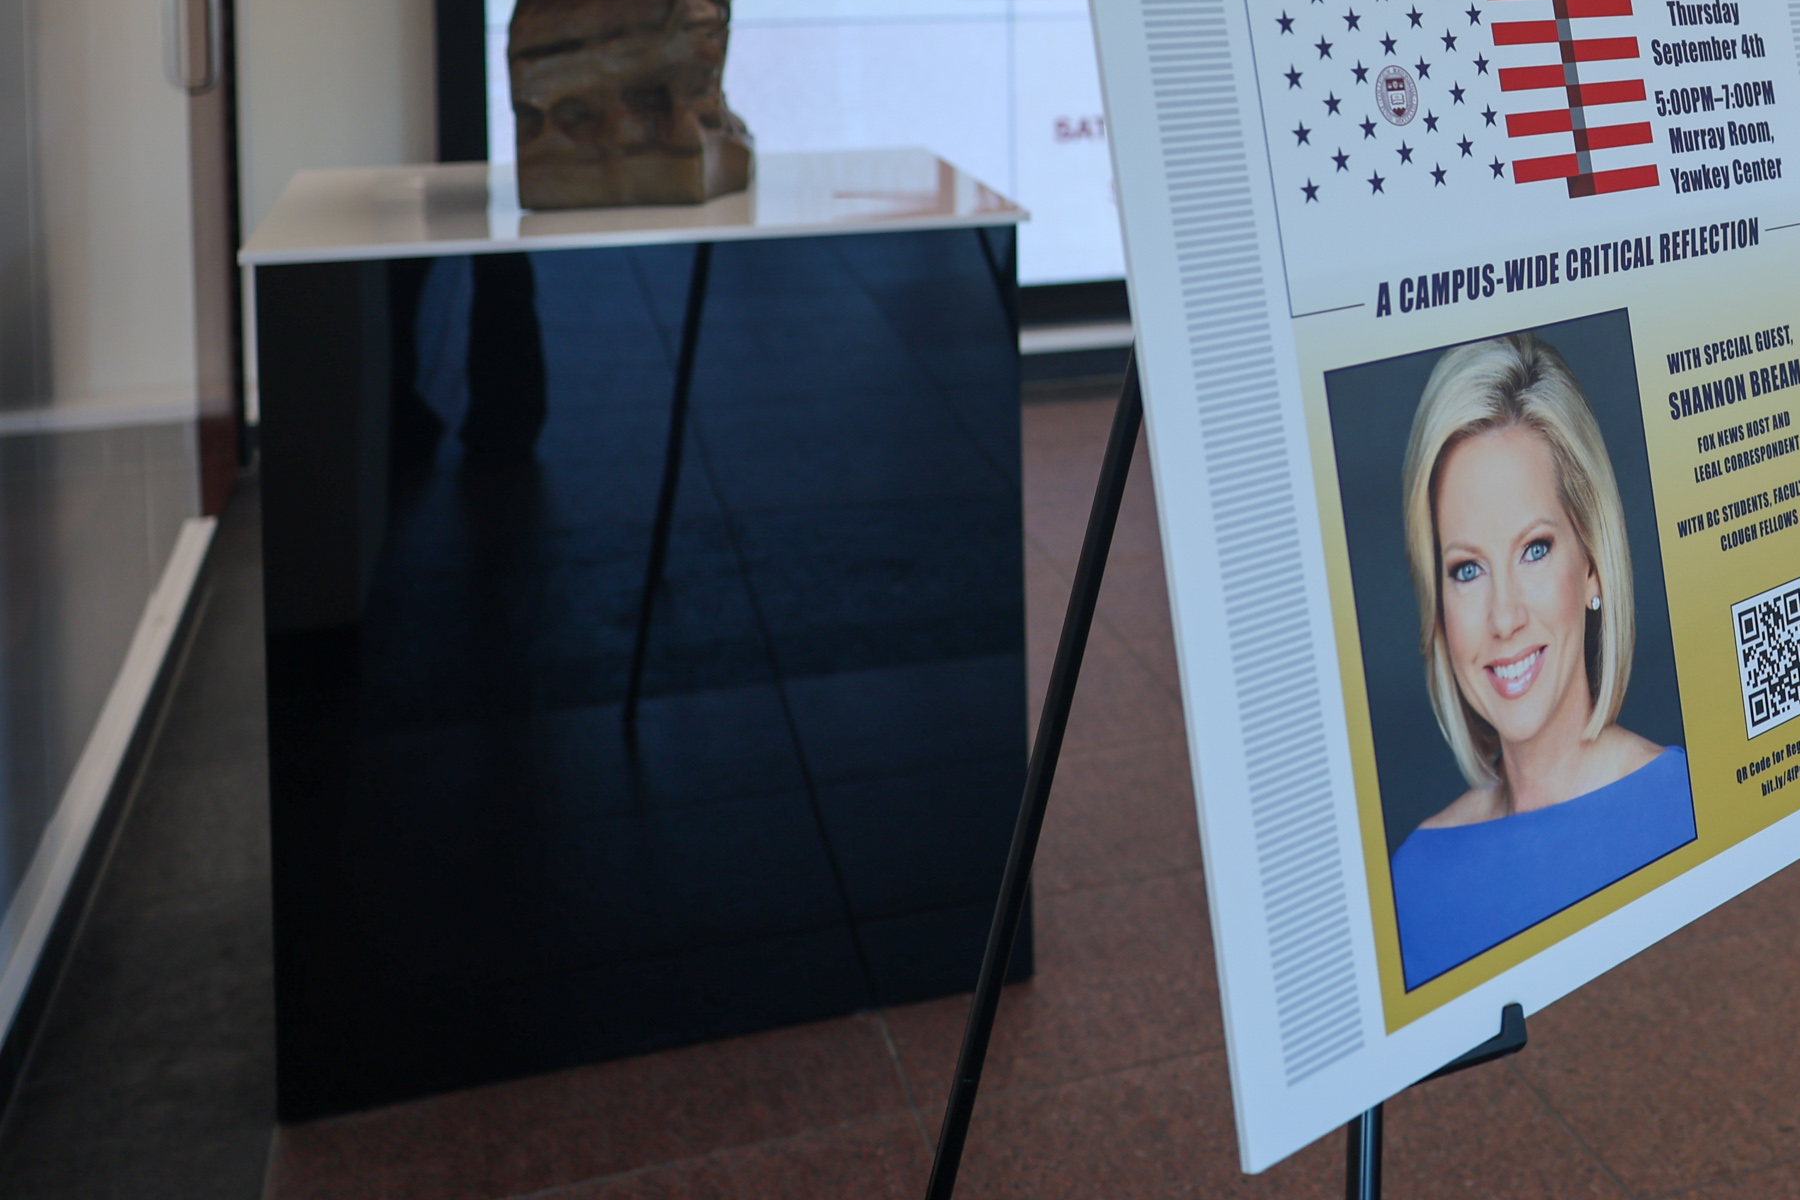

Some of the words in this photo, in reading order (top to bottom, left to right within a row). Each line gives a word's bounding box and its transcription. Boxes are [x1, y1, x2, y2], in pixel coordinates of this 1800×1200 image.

[1666, 0, 1740, 26] Thursday
[1651, 36, 1737, 67] September
[1741, 33, 1766, 58] 4th
[1668, 126, 1726, 154] Murray
[1727, 120, 1775, 147] Room,
[1670, 164, 1730, 194] Yawkey
[1732, 157, 1782, 185] Center
[1376, 282, 1391, 317] A
[1399, 252, 1560, 313] CAMPUS-WIDE
[1565, 236, 1654, 282] CRITICAL
[1659, 217, 1760, 263] REFLECTION
[1666, 347, 1702, 375] WITH
[1703, 335, 1753, 366] SPECIAL
[1755, 324, 1794, 352] GUEST,
[1668, 373, 1747, 421] SHANNON
[1697, 433, 1716, 454] FOX
[1717, 425, 1745, 447] NEWS
[1746, 416, 1770, 439] HOST
[1772, 411, 1791, 430] AND
[1694, 460, 1723, 483] LEGAL
[1724, 434, 1800, 473] CORRESPONDENT
[1677, 514, 1705, 538] WITH
[1706, 508, 1721, 528] BC
[1721, 491, 1773, 523] STUDENTS,
[1720, 526, 1758, 552] CLOUGH
[1759, 509, 1799, 537] FELLOWS
[1736, 766, 1748, 784] QR
[1749, 756, 1771, 777] Code
[1772, 749, 1784, 765] for
